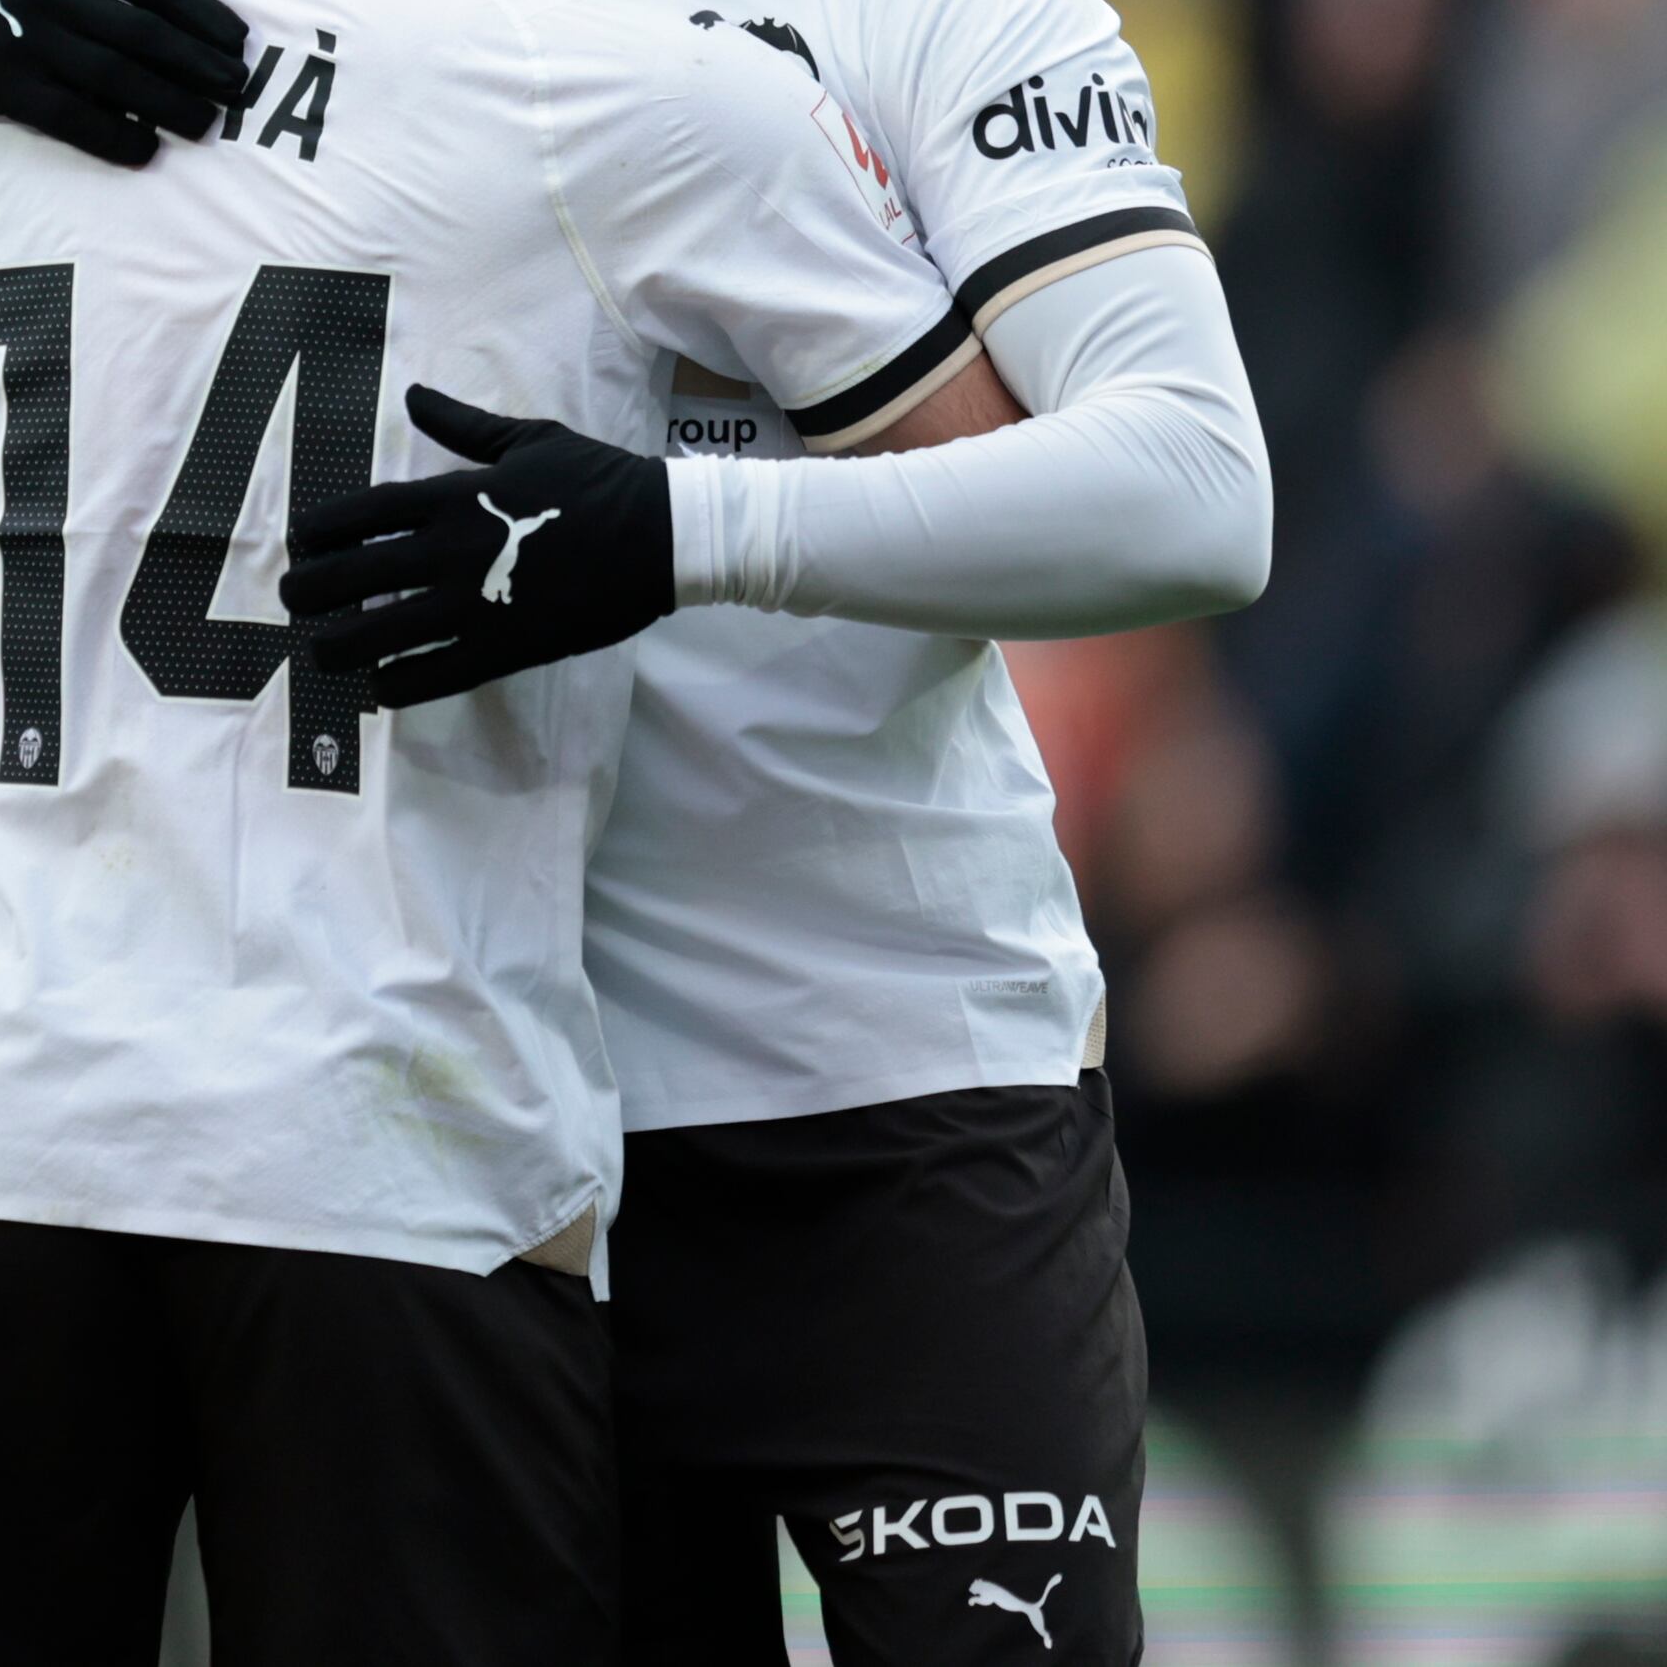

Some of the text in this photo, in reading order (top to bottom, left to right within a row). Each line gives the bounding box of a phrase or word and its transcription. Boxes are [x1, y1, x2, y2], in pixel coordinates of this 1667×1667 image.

[220, 27, 337, 163] YÀ
[972, 72, 1149, 160] divin
[666, 418, 757, 453] roup
[969, 979, 1049, 995] ULTRAWEAVE
[829, 1491, 1116, 1563] SKODA
